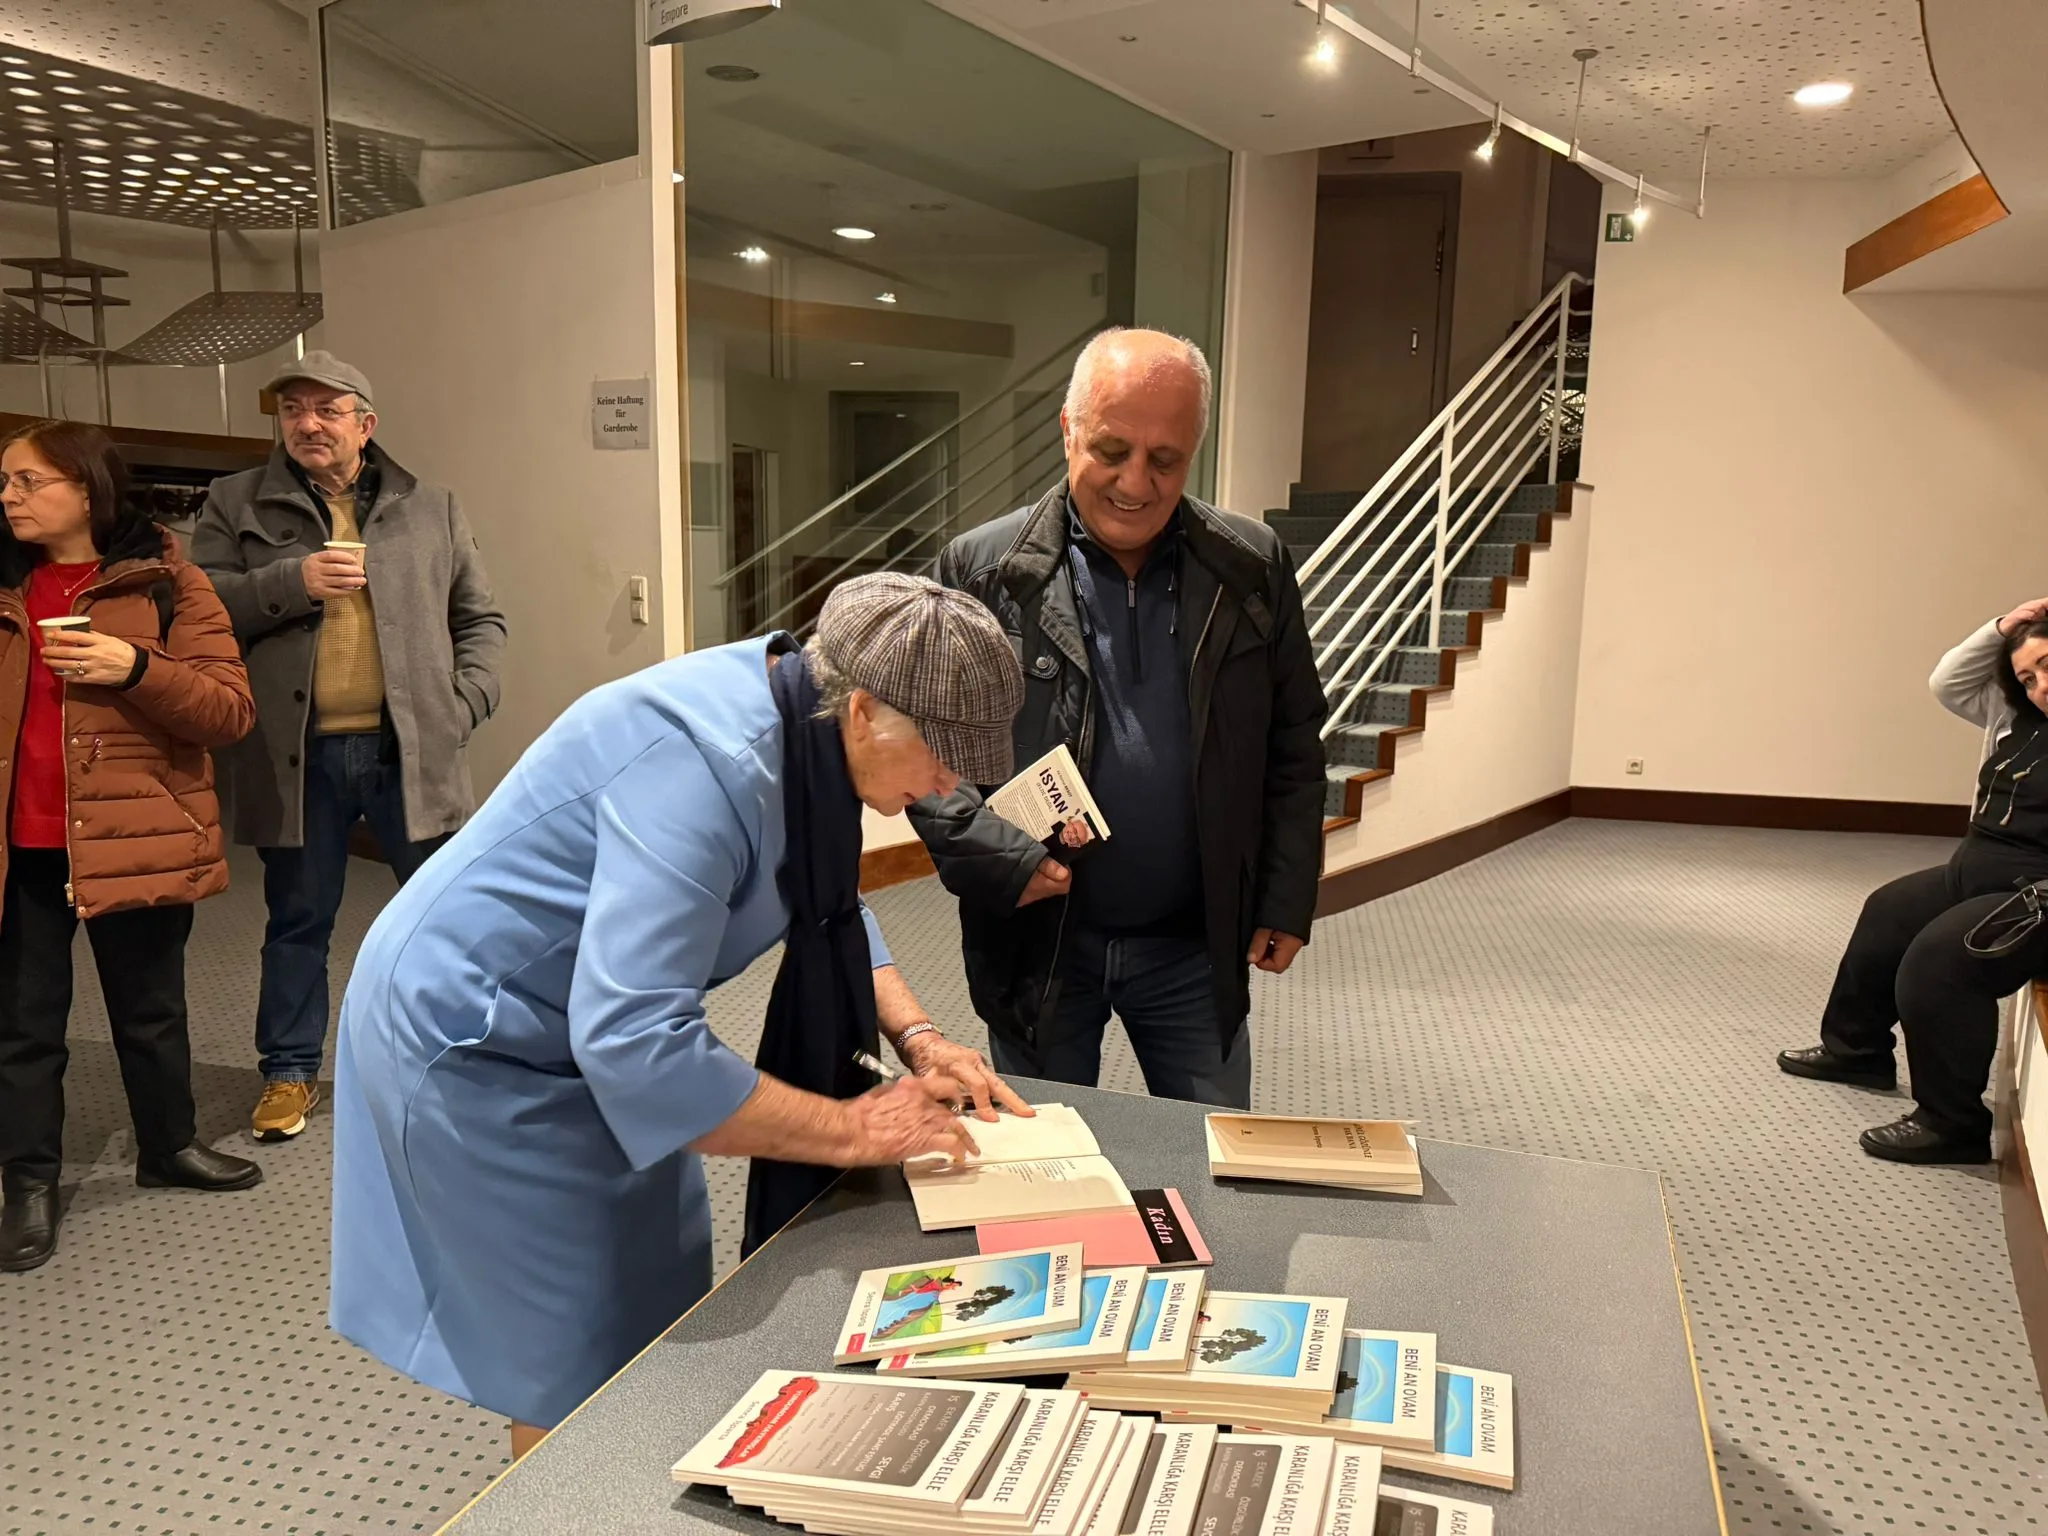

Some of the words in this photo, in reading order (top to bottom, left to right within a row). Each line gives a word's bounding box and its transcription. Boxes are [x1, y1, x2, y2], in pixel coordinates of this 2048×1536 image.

[661, 4, 688, 25] Empore
[597, 396, 616, 406] Keine
[617, 395, 644, 406] Haftung
[615, 409, 626, 418] für
[603, 423, 638, 432] Garderobe
[1039, 767, 1069, 814] İSYAN
[1146, 1207, 1174, 1244] Kadın
[1056, 1255, 1070, 1271] BENİ
[1054, 1273, 1066, 1286] AN
[1112, 1279, 1128, 1297] BENİ
[1169, 1283, 1186, 1301] BENİ
[1052, 1286, 1066, 1308] OVAM
[1107, 1299, 1122, 1312] AN
[1166, 1303, 1180, 1316] AN
[1098, 1313, 1118, 1338] OVAM
[1158, 1316, 1177, 1342] OVAM
[1313, 1308, 1330, 1330] BENİ
[1311, 1329, 1325, 1343] AN
[1304, 1344, 1323, 1372] OVAM
[1404, 1348, 1421, 1372] BENİ
[1403, 1372, 1418, 1388] AN
[1401, 1388, 1417, 1419] OVAM
[1480, 1385, 1499, 1407] BENİ
[960, 1391, 1000, 1439] KARANLIĞA
[1024, 1398, 1056, 1447] KARANLIĞA
[1480, 1408, 1496, 1423] AN
[1064, 1419, 1097, 1469] KARANLIĞA
[1480, 1424, 1496, 1454] OVAM
[942, 1439, 971, 1468] KARŞI
[1005, 1449, 1034, 1476] KARŞI
[1165, 1432, 1193, 1480] KARANLIĞA
[868, 1456, 892, 1479] SEVGİ
[926, 1467, 953, 1492] ELELE
[1283, 1445, 1310, 1495] KARANLIĞA
[993, 1477, 1019, 1503] ELELE
[1153, 1480, 1179, 1507] KARŞI
[1335, 1455, 1360, 1510] KARANLIĞA
[1272, 1497, 1298, 1524] KARŞI
[1327, 1511, 1351, 1536] KARŞ
